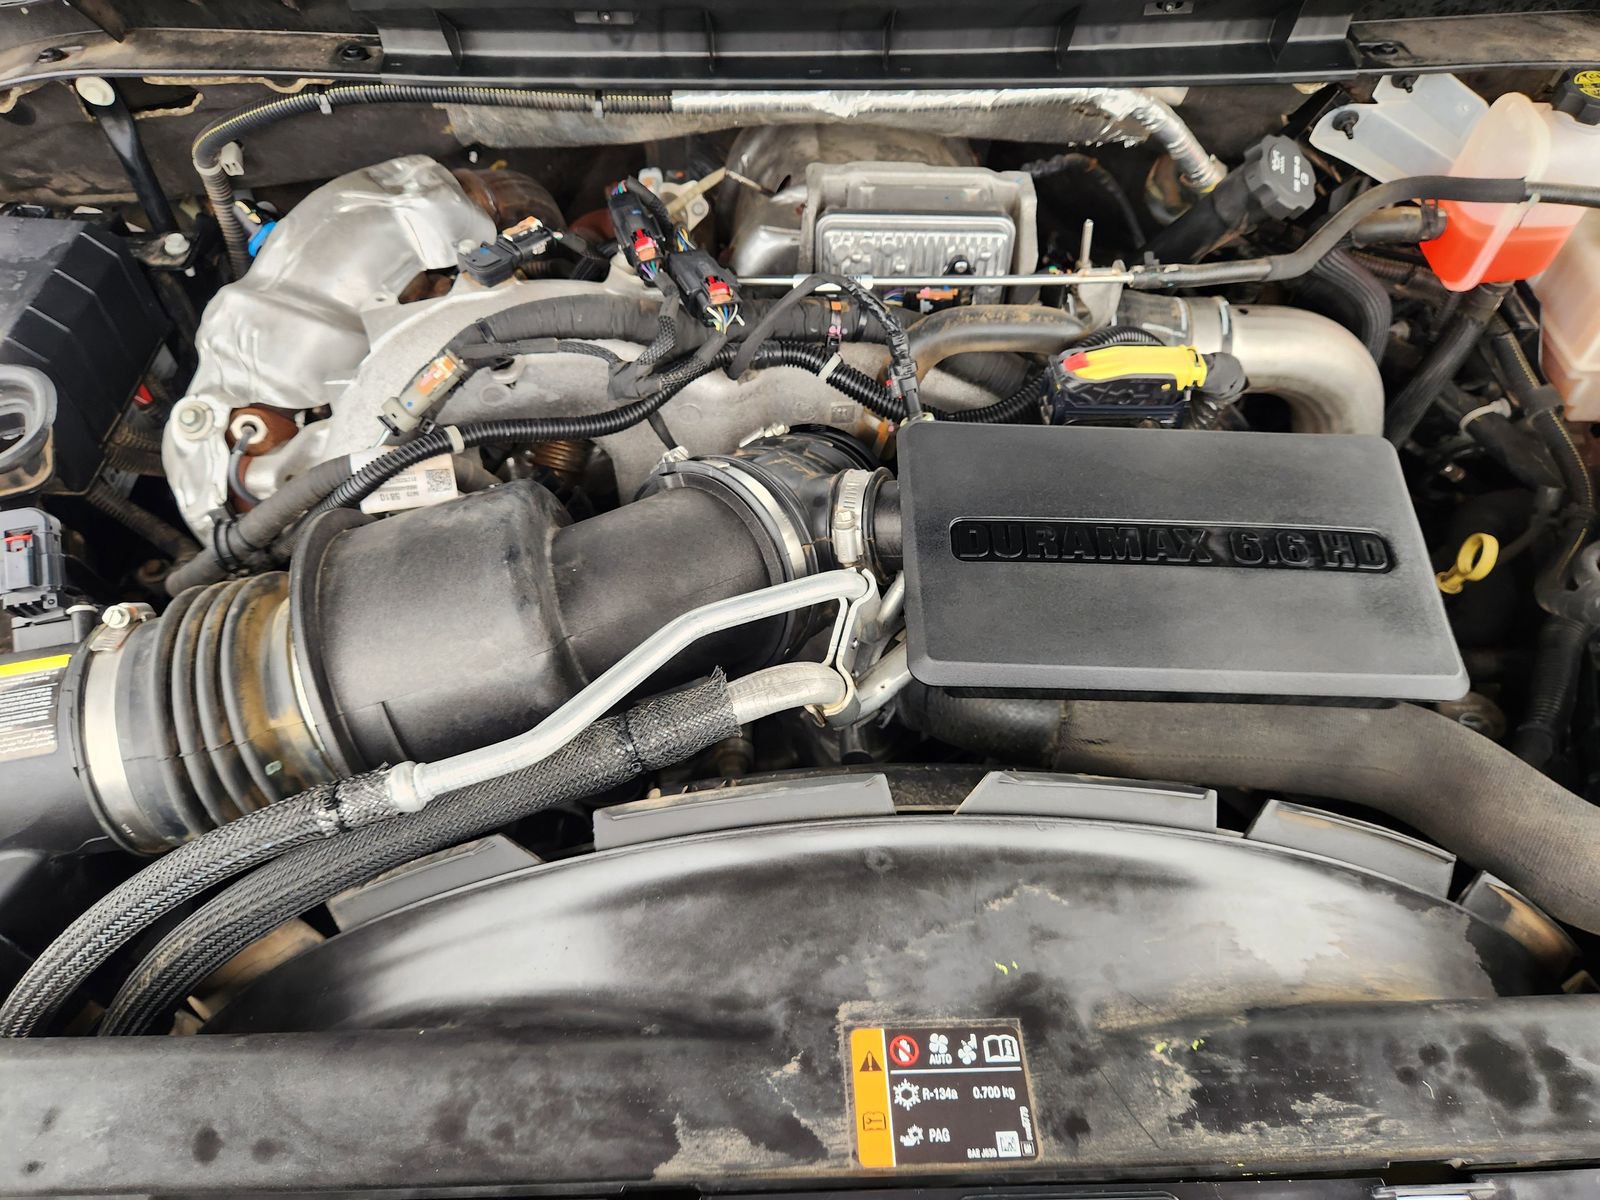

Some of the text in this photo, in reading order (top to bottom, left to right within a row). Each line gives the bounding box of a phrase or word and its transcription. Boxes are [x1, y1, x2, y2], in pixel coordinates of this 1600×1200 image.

[958, 525, 1388, 570] DURAMAX 6.6 HD
[929, 1053, 953, 1065] AUTO
[922, 1085, 1016, 1101] R-134a 0.700 kg
[928, 1127, 951, 1143] PAG
